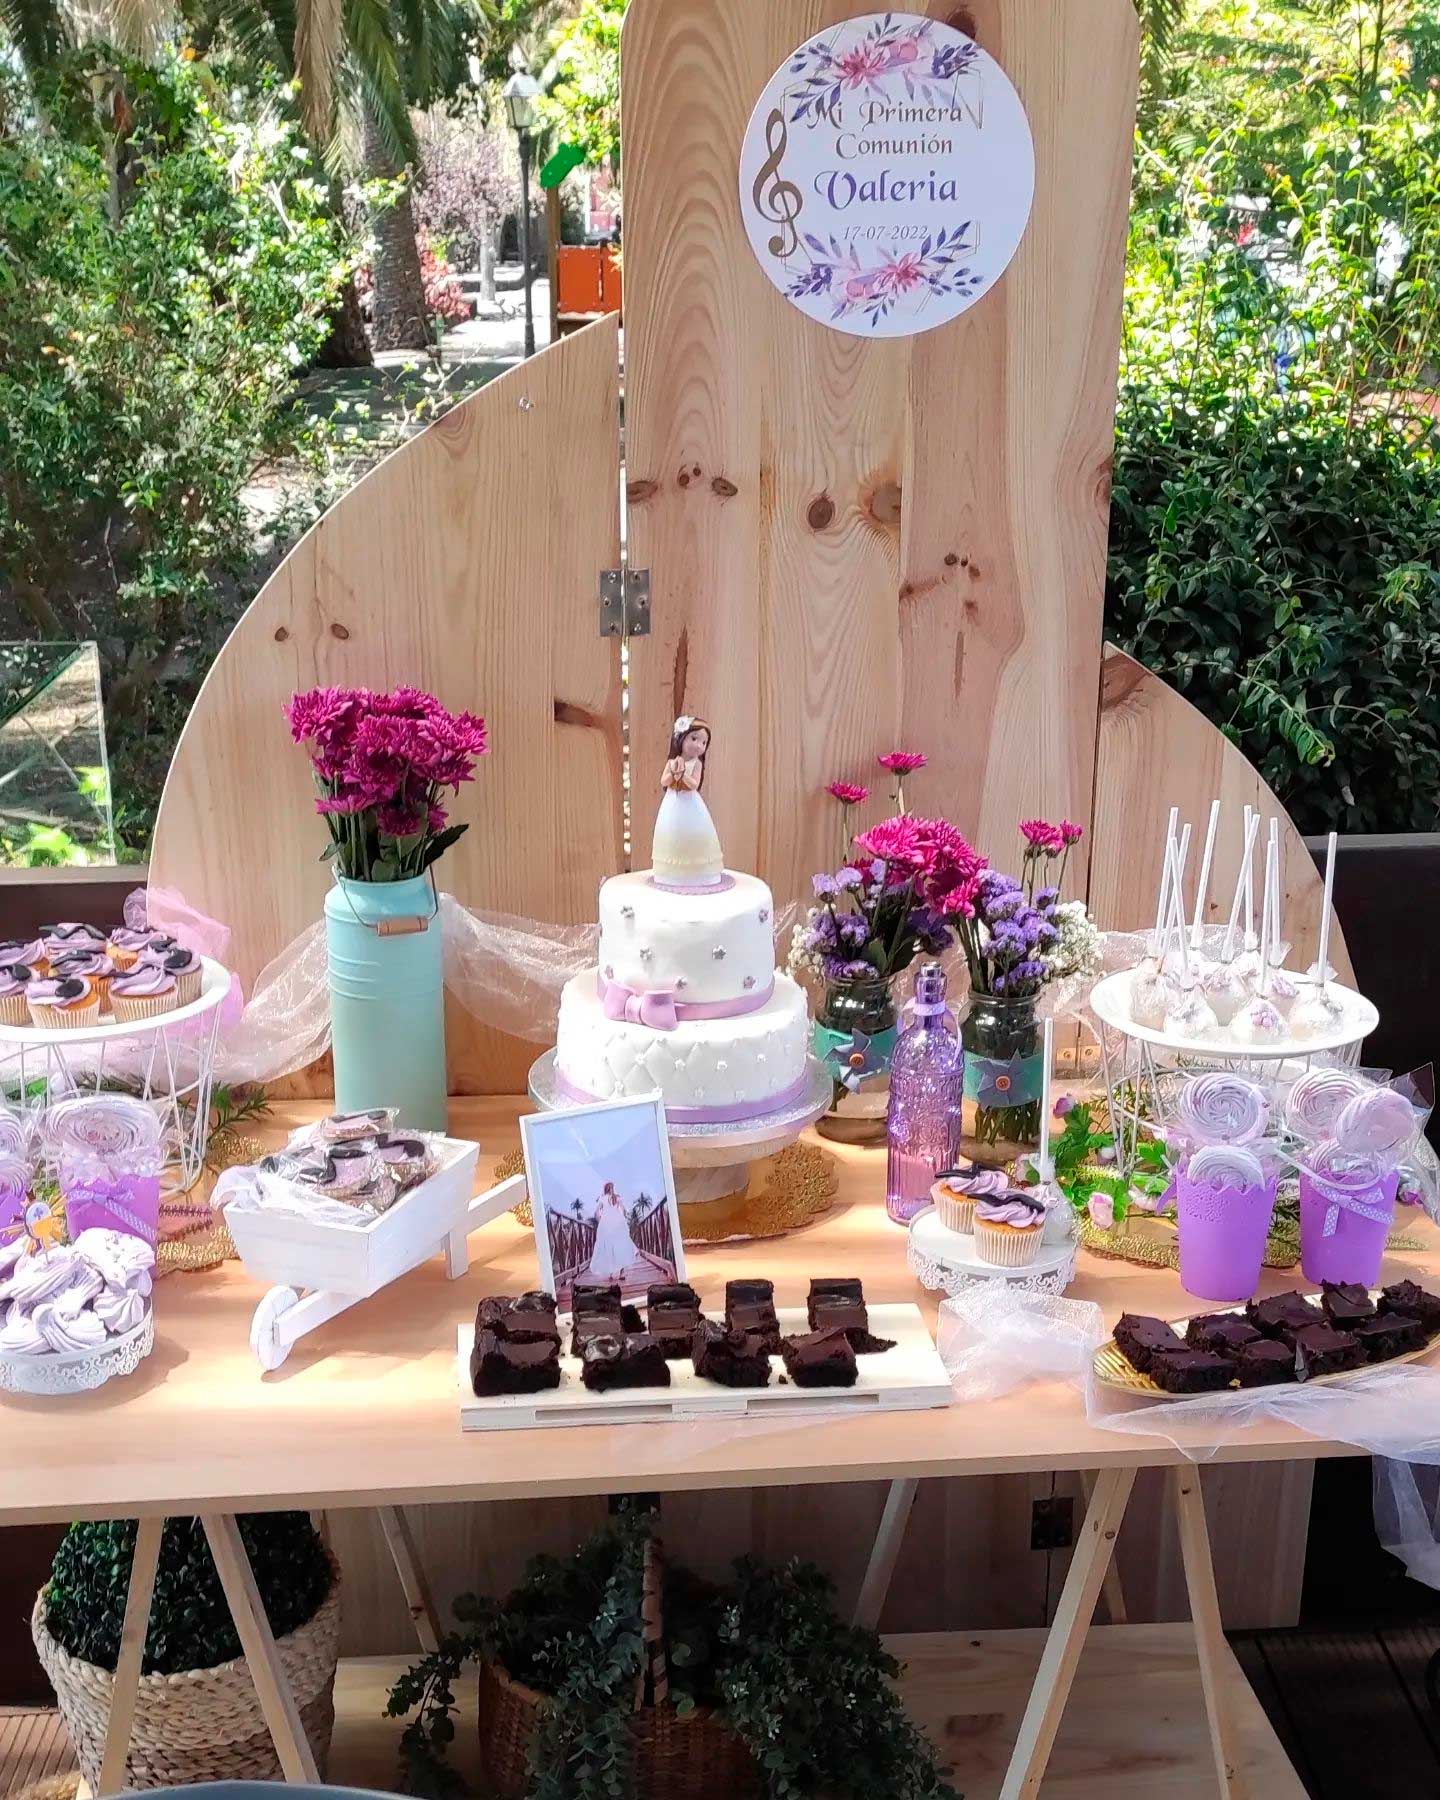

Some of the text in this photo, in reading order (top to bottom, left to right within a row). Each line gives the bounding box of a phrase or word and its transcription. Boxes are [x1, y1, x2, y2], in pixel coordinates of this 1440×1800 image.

[806, 97, 962, 132] Mi Primera
[835, 133, 952, 160] Comunión
[814, 169, 959, 211] Valeria
[843, 224, 929, 241] 17-07-2022
